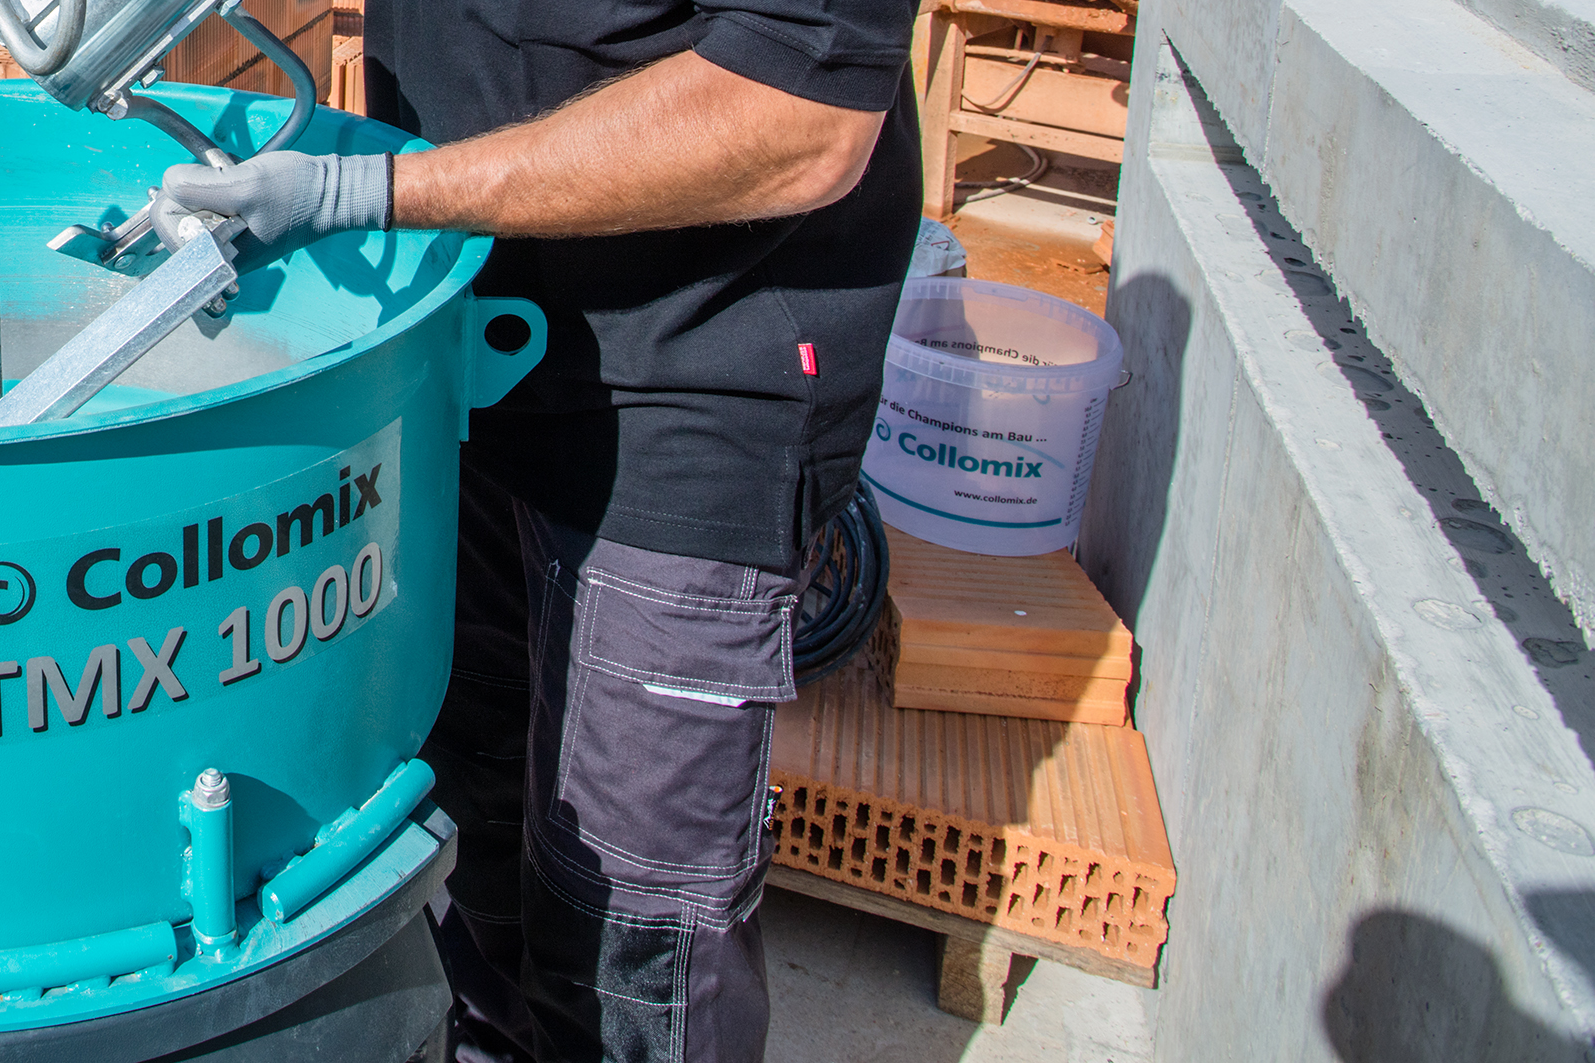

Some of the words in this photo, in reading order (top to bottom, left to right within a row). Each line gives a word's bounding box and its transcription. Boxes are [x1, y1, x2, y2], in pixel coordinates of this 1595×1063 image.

[889, 400, 905, 415] die
[908, 409, 978, 437] Champions
[982, 430, 1003, 440] am
[1008, 432, 1033, 442] Bau
[898, 432, 1044, 478] Collomix
[954, 489, 1038, 505] www.collomix.de
[66, 462, 383, 611] Collomix
[217, 541, 383, 686] 1000
